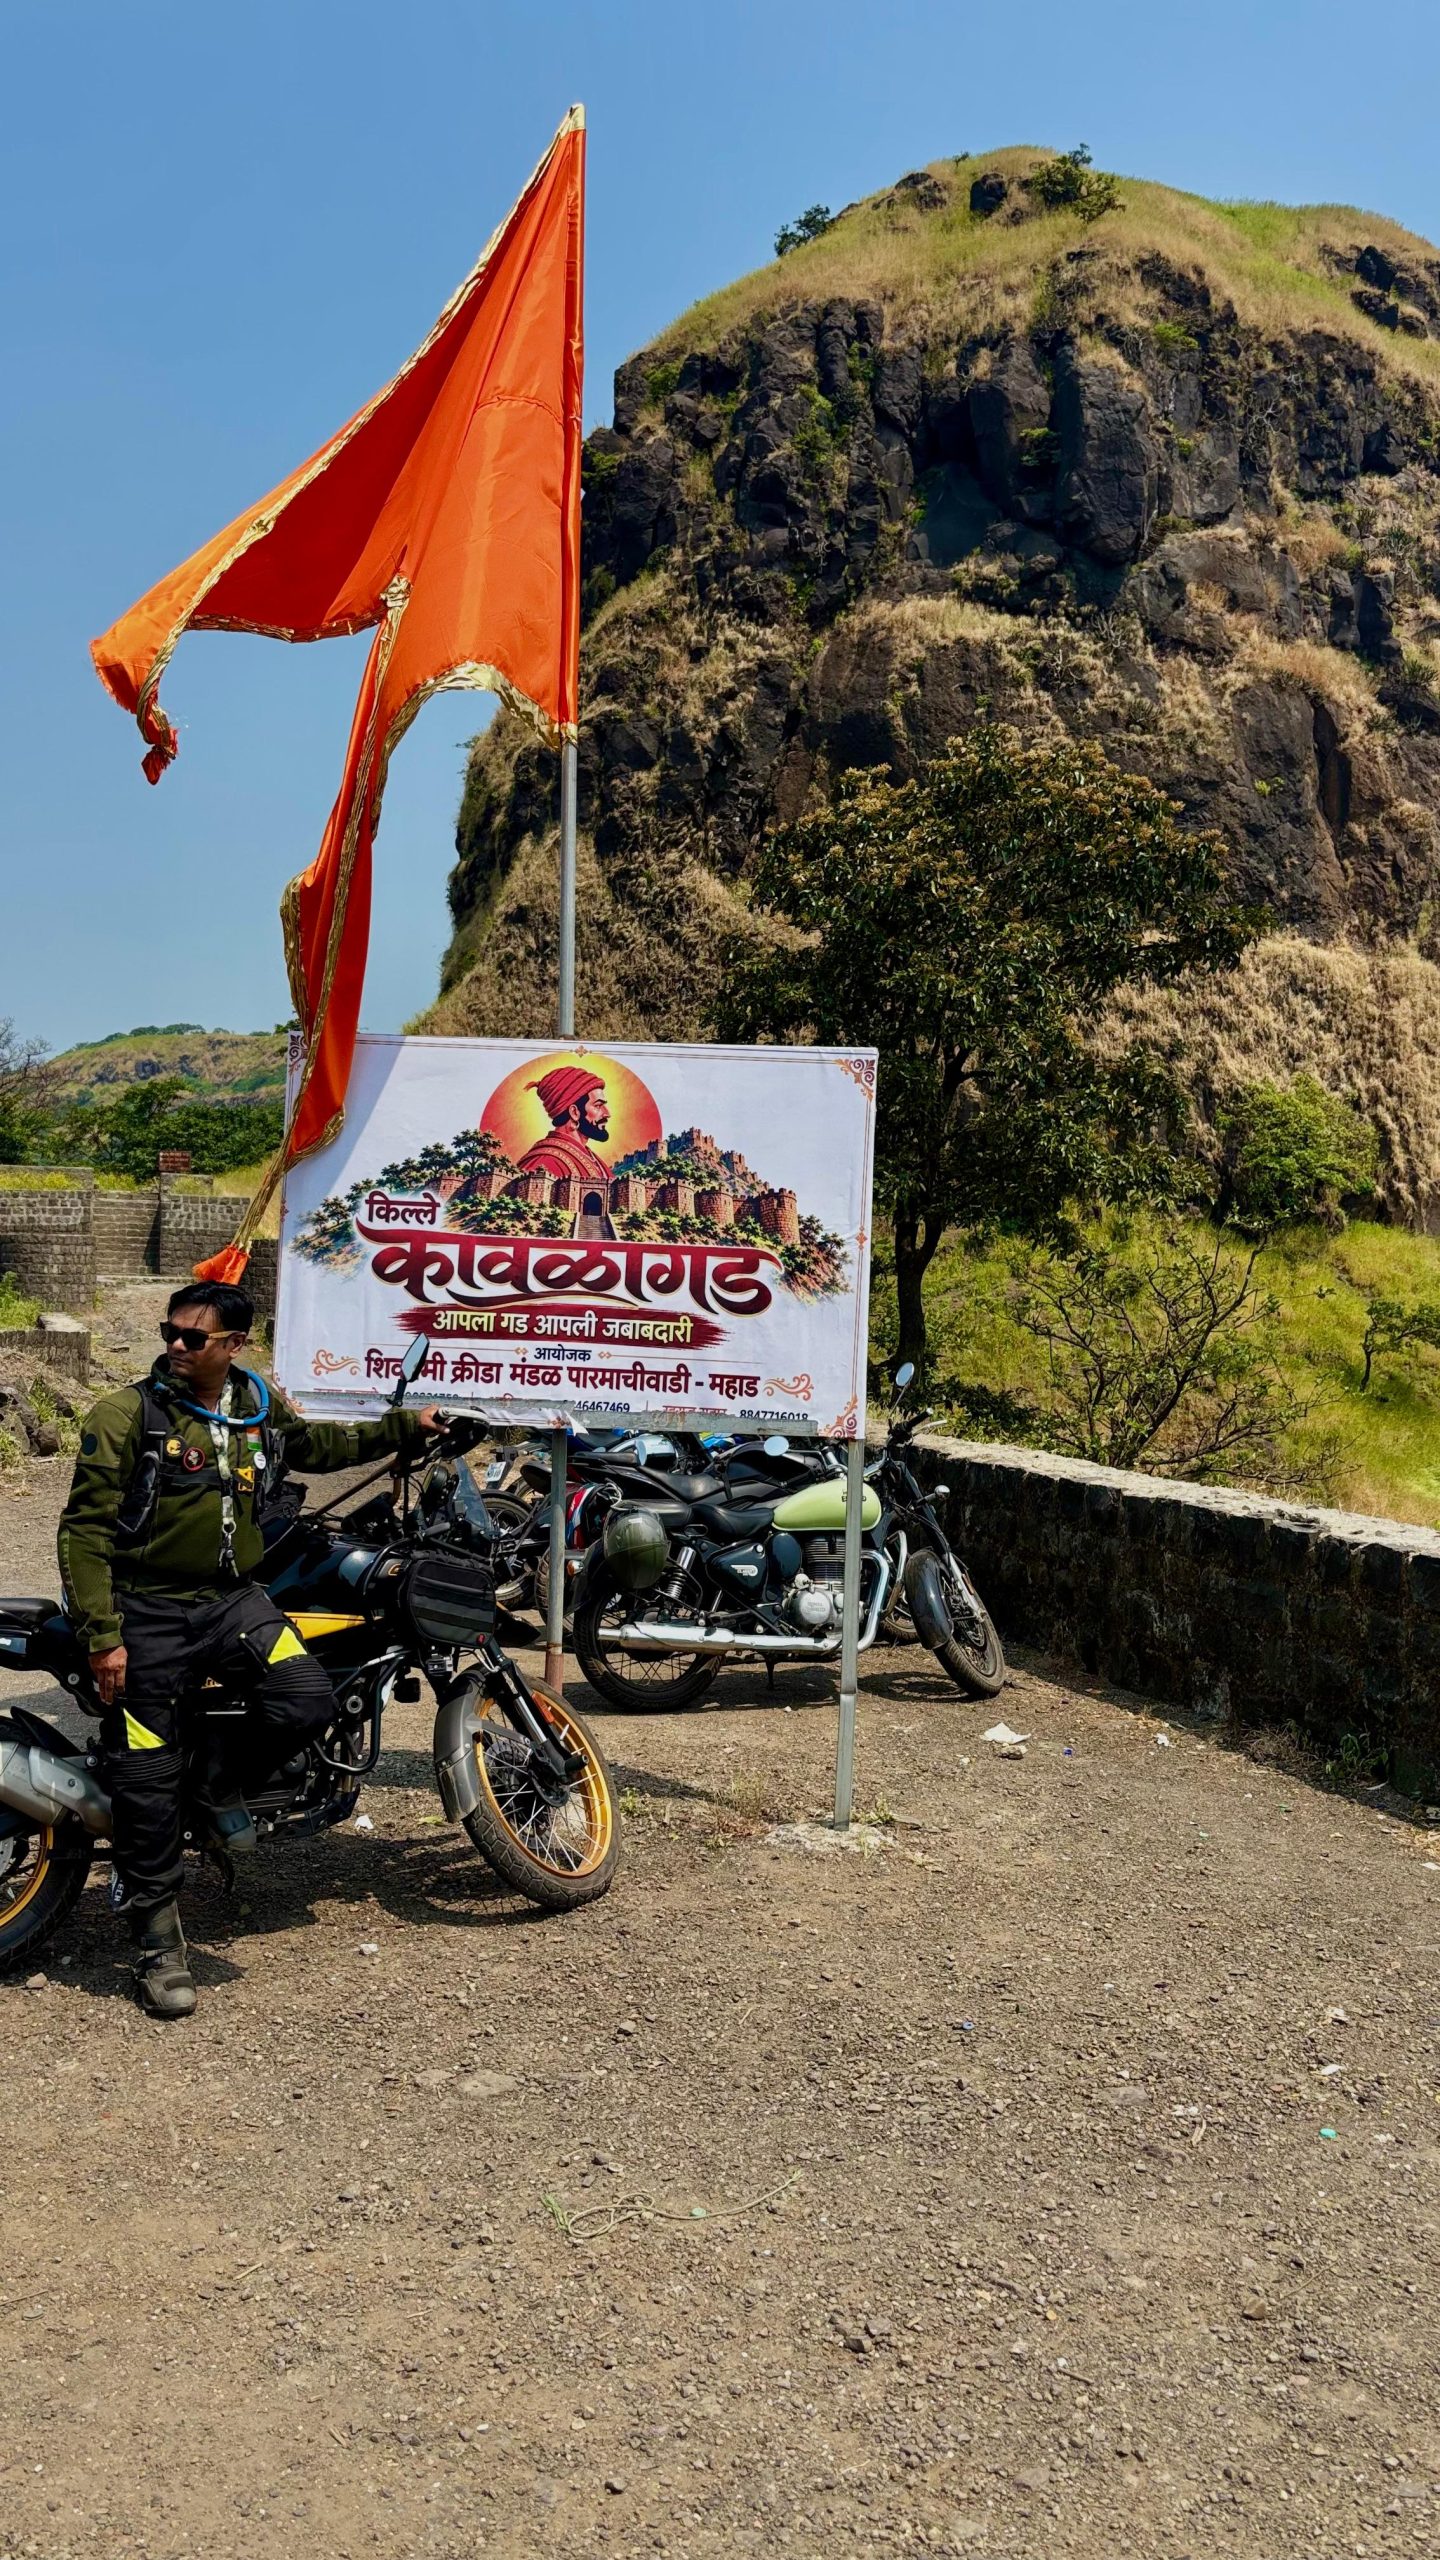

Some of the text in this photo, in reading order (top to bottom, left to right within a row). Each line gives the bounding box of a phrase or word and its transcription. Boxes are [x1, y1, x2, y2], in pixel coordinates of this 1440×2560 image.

[364, 1189, 441, 1226] किल्ले
[432, 1310, 694, 1344] आपला गड आपली जबाबदारी
[533, 1343, 592, 1363] आयोजक
[451, 1352, 503, 1385] क्रीडा
[510, 1357, 563, 1388] मंडळ
[567, 1361, 692, 1394] पारमाचीवाडी
[709, 1373, 761, 1400] महाड
